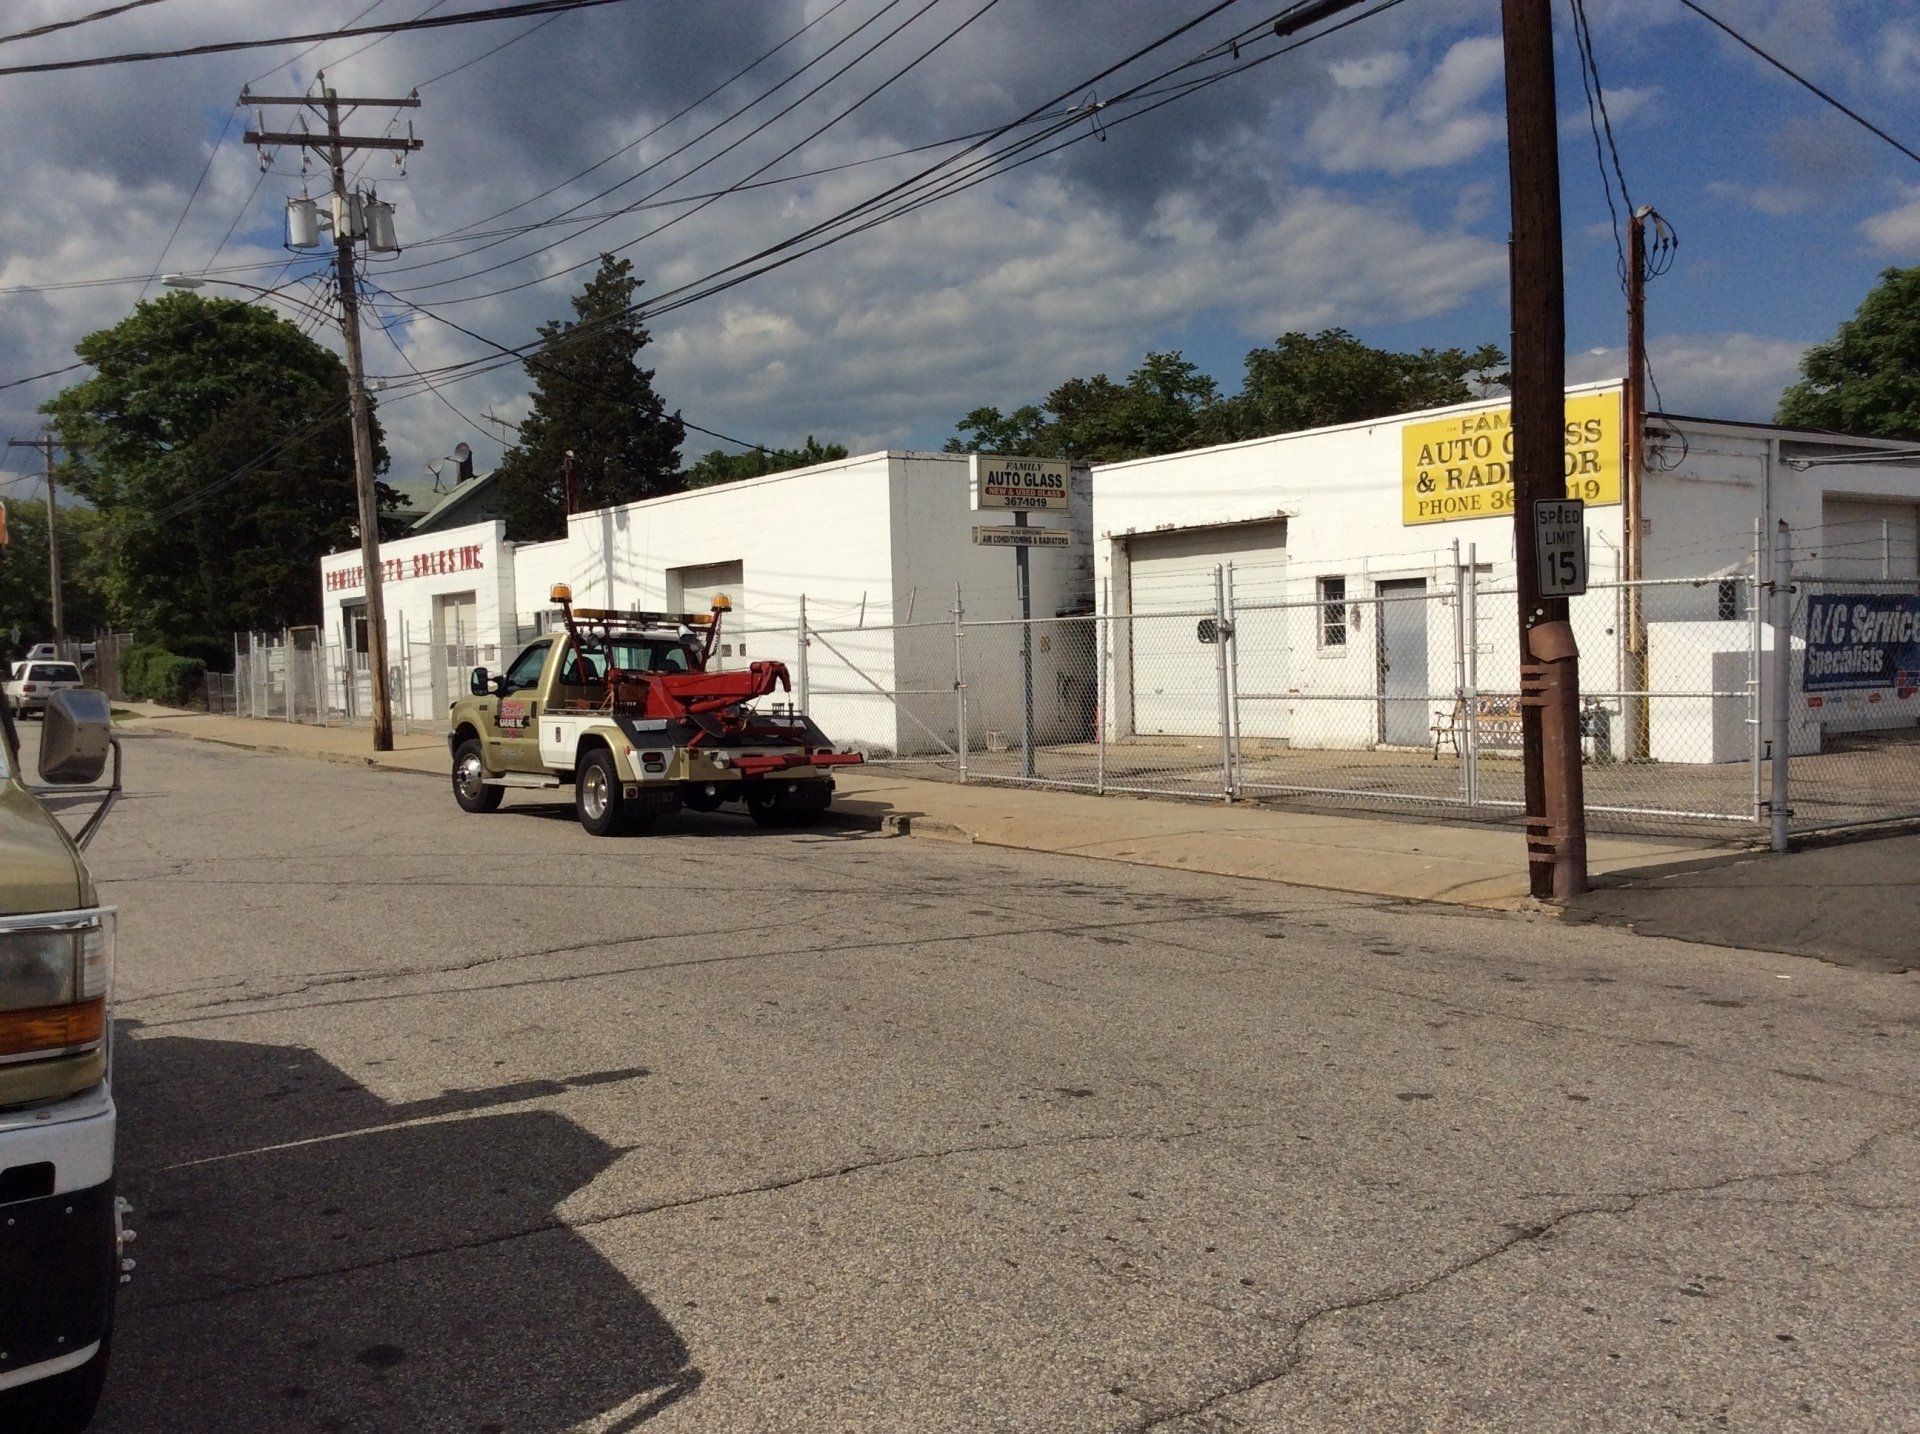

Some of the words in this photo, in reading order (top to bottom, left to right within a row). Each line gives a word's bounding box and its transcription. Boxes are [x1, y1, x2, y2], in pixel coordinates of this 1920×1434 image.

[1461, 412, 1512, 435] FAM
[1416, 434, 1493, 467] AUTO
[1501, 418, 1603, 457] GSS
[1005, 462, 1045, 472] FAMILY
[1416, 470, 1437, 494] &
[1445, 449, 1602, 491] RADIOR
[987, 471, 1021, 486] AUTO
[1024, 473, 1063, 489] GLASS
[1004, 497, 1047, 508] 367-1019
[1016, 489, 1036, 497] USED
[1037, 490, 1062, 498] GLASS
[1418, 494, 1482, 517] PHONE
[1490, 479, 1602, 510] 3619
[1539, 510, 1581, 525] SPEED
[982, 535, 992, 544] AIR
[993, 535, 1032, 545] CONDITIONING
[1038, 537, 1069, 545] RADIATORS
[1545, 531, 1576, 546] LIMIT
[413, 548, 456, 579] SALES
[1548, 551, 1577, 586] 15
[1809, 603, 1847, 644] A/C
[1808, 644, 1884, 677] Specialists
